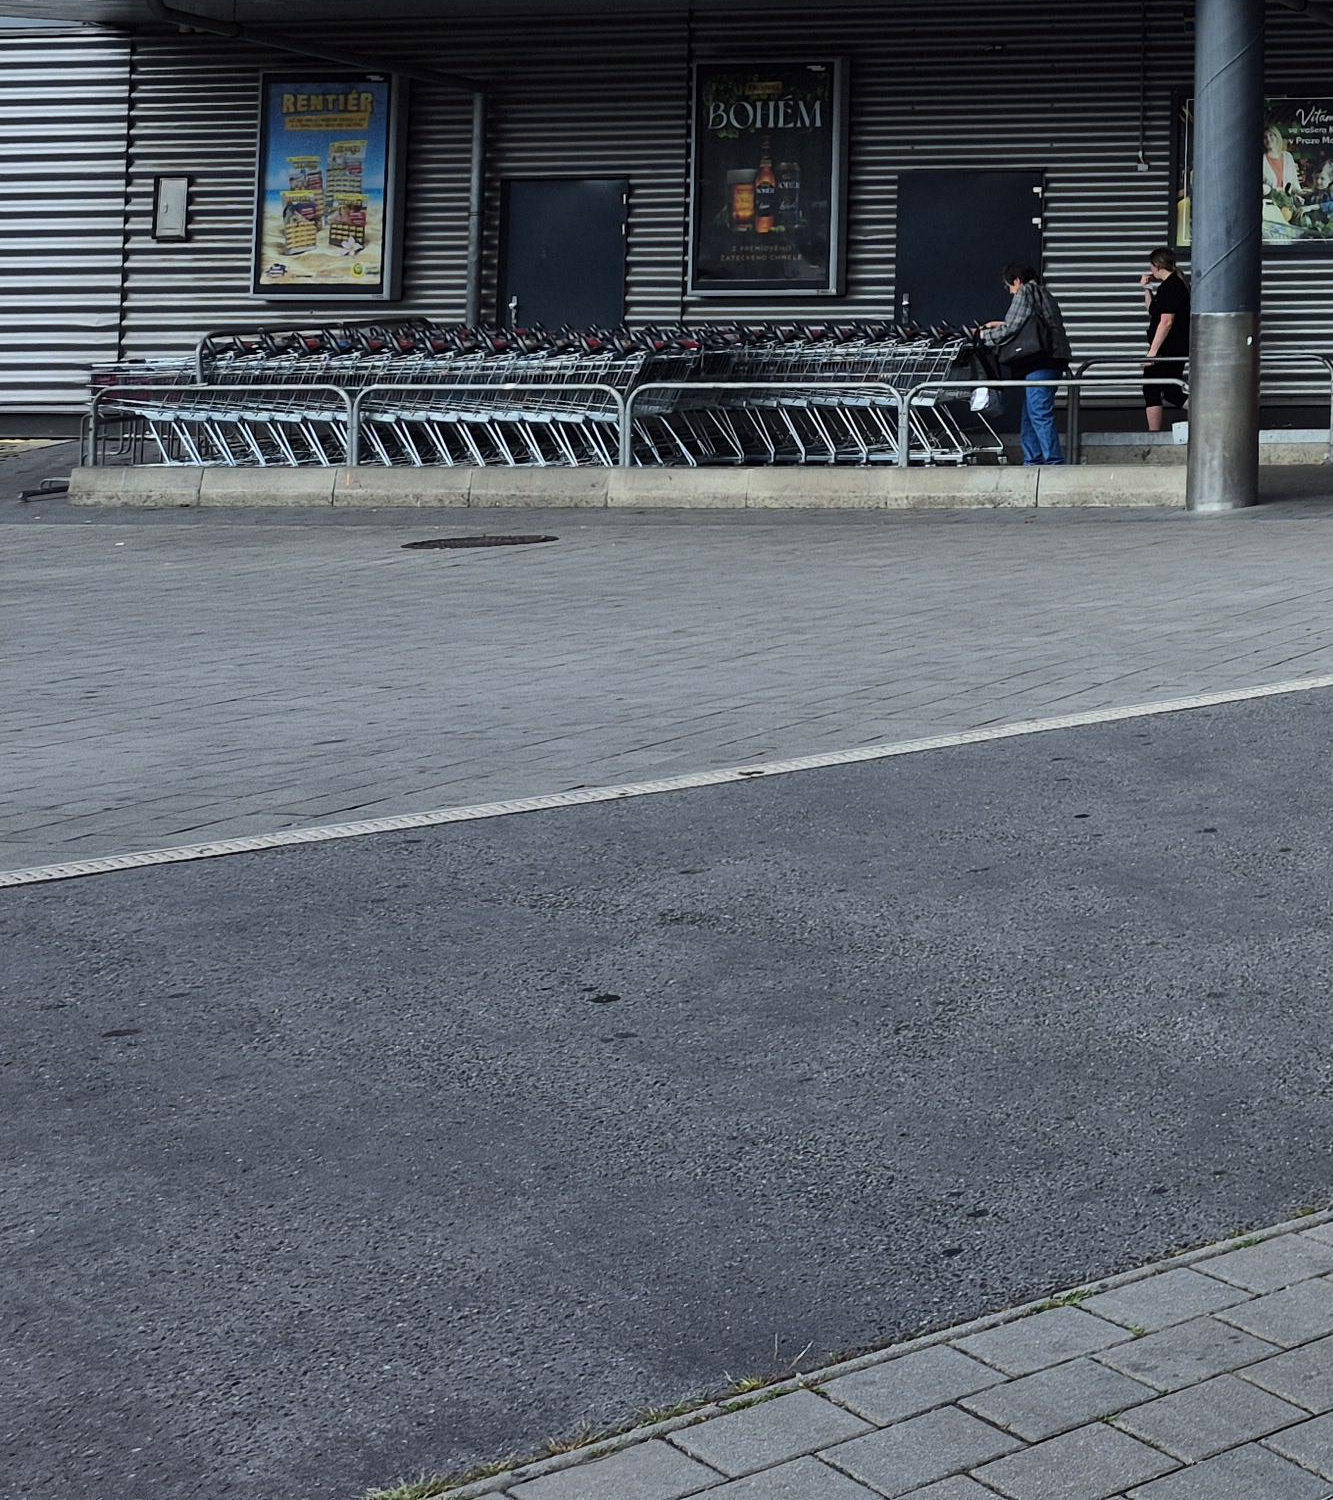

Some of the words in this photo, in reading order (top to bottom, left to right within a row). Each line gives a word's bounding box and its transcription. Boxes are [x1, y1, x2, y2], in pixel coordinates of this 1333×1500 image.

[282, 90, 374, 114] RENTIÉR
[707, 96, 823, 129] BOHÉM
[1300, 125, 1327, 134] vašem
[1295, 136, 1320, 145] Praze
